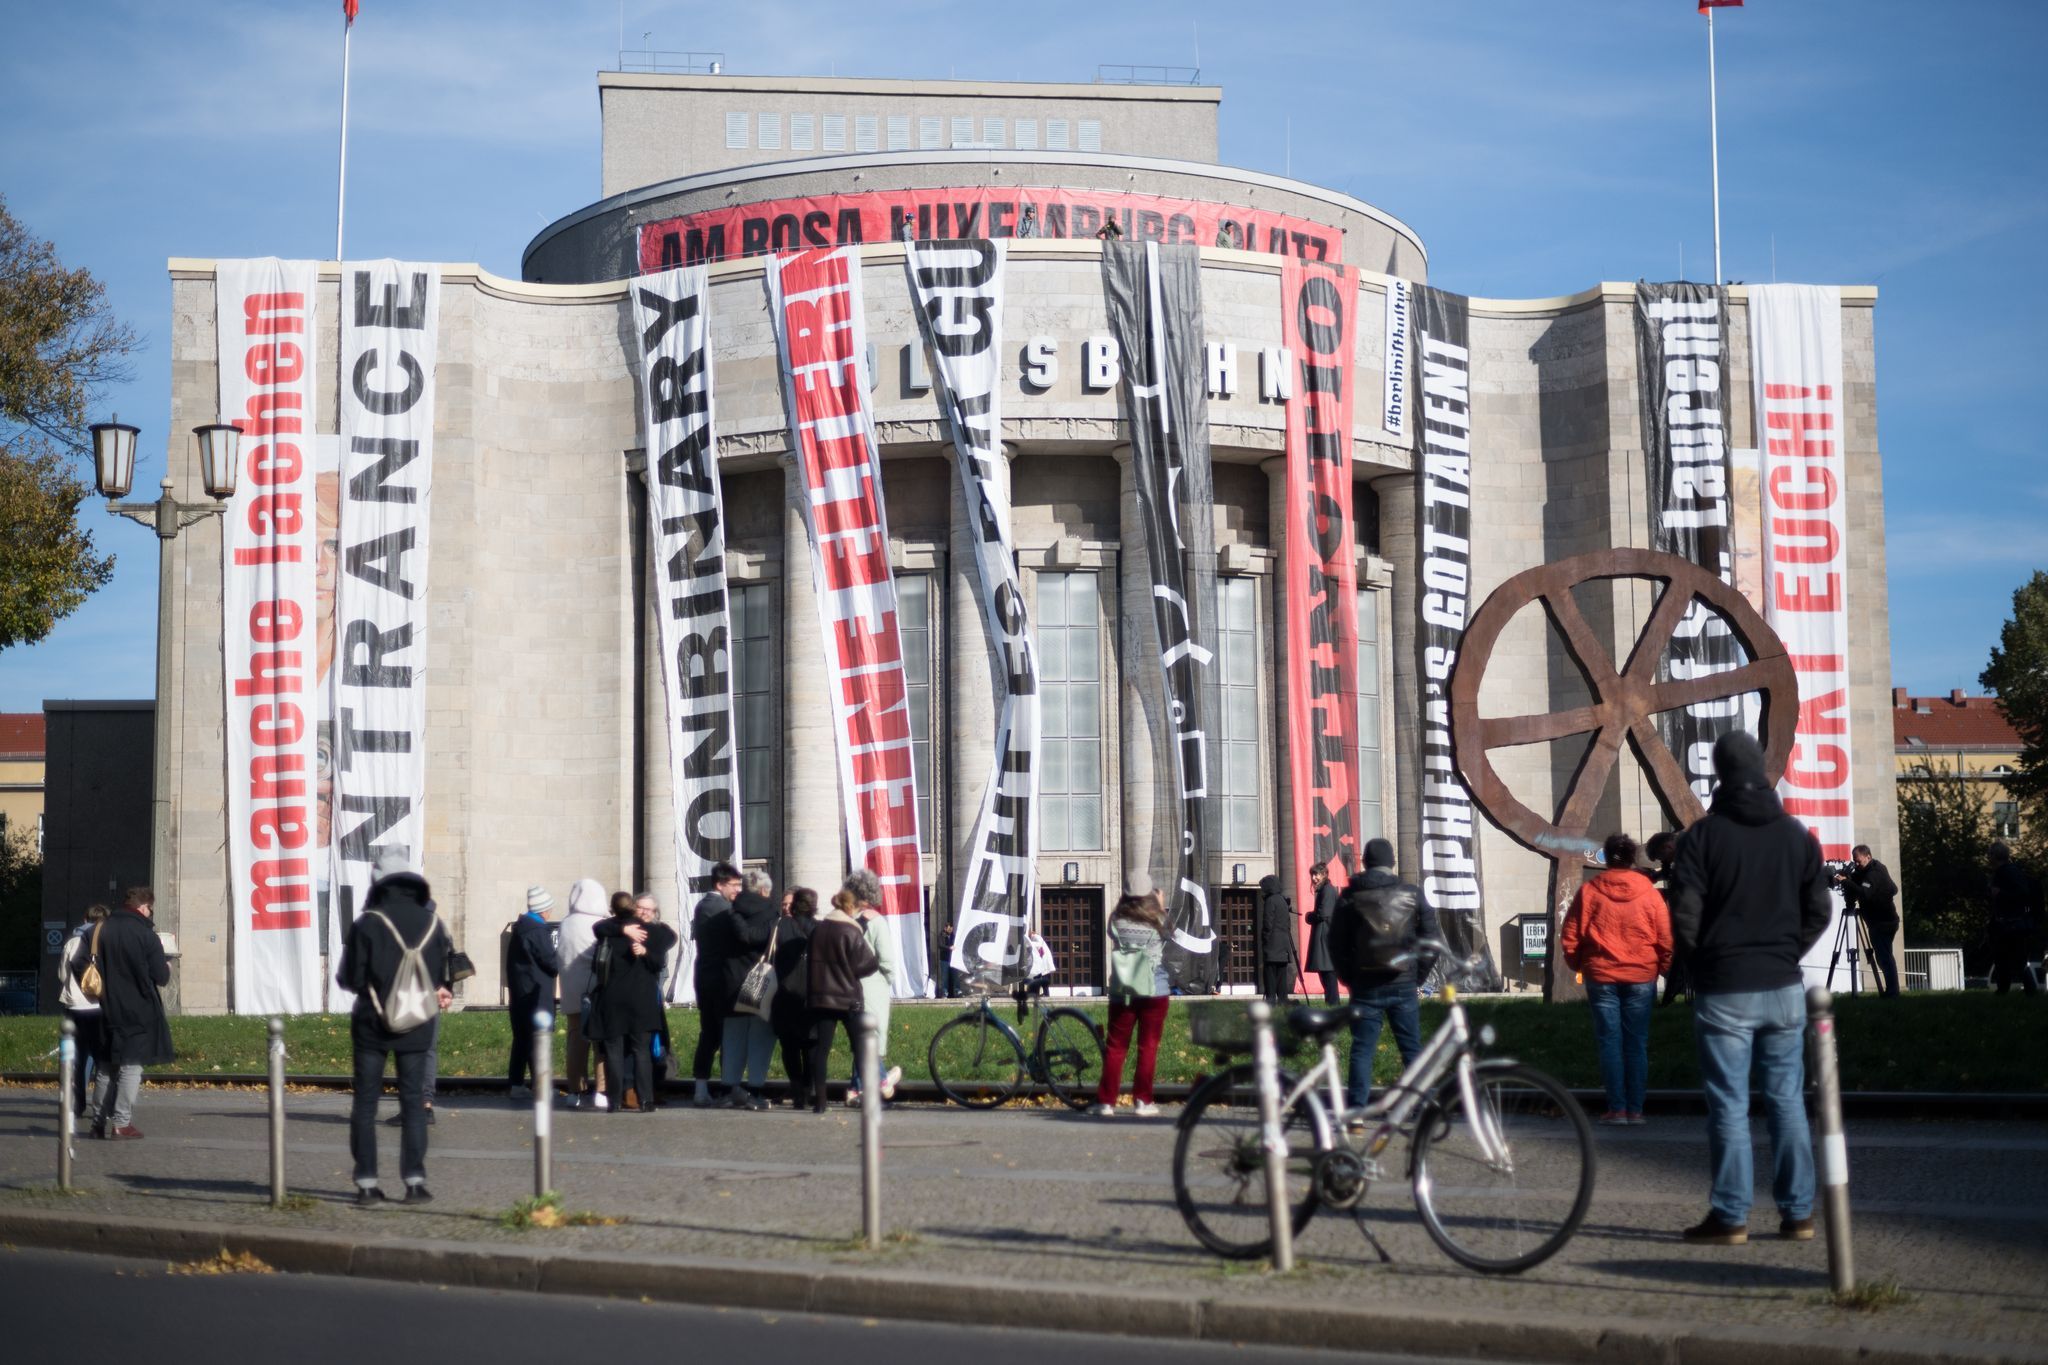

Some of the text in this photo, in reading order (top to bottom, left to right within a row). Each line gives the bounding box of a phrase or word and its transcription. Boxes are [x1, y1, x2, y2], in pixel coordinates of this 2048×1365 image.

[1421, 330, 1472, 509] TALENT
[1648, 297, 1728, 529] Laurent
[1764, 383, 1843, 613] EUCH!
[231, 291, 311, 932] manche lachen
[639, 286, 737, 938] ONBINARY
[1297, 260, 1355, 876] XTINCTIO
[1422, 523, 1470, 632] GOT
[833, 610, 921, 916] DEINE
[1526, 925, 1546, 937] LEBEN
